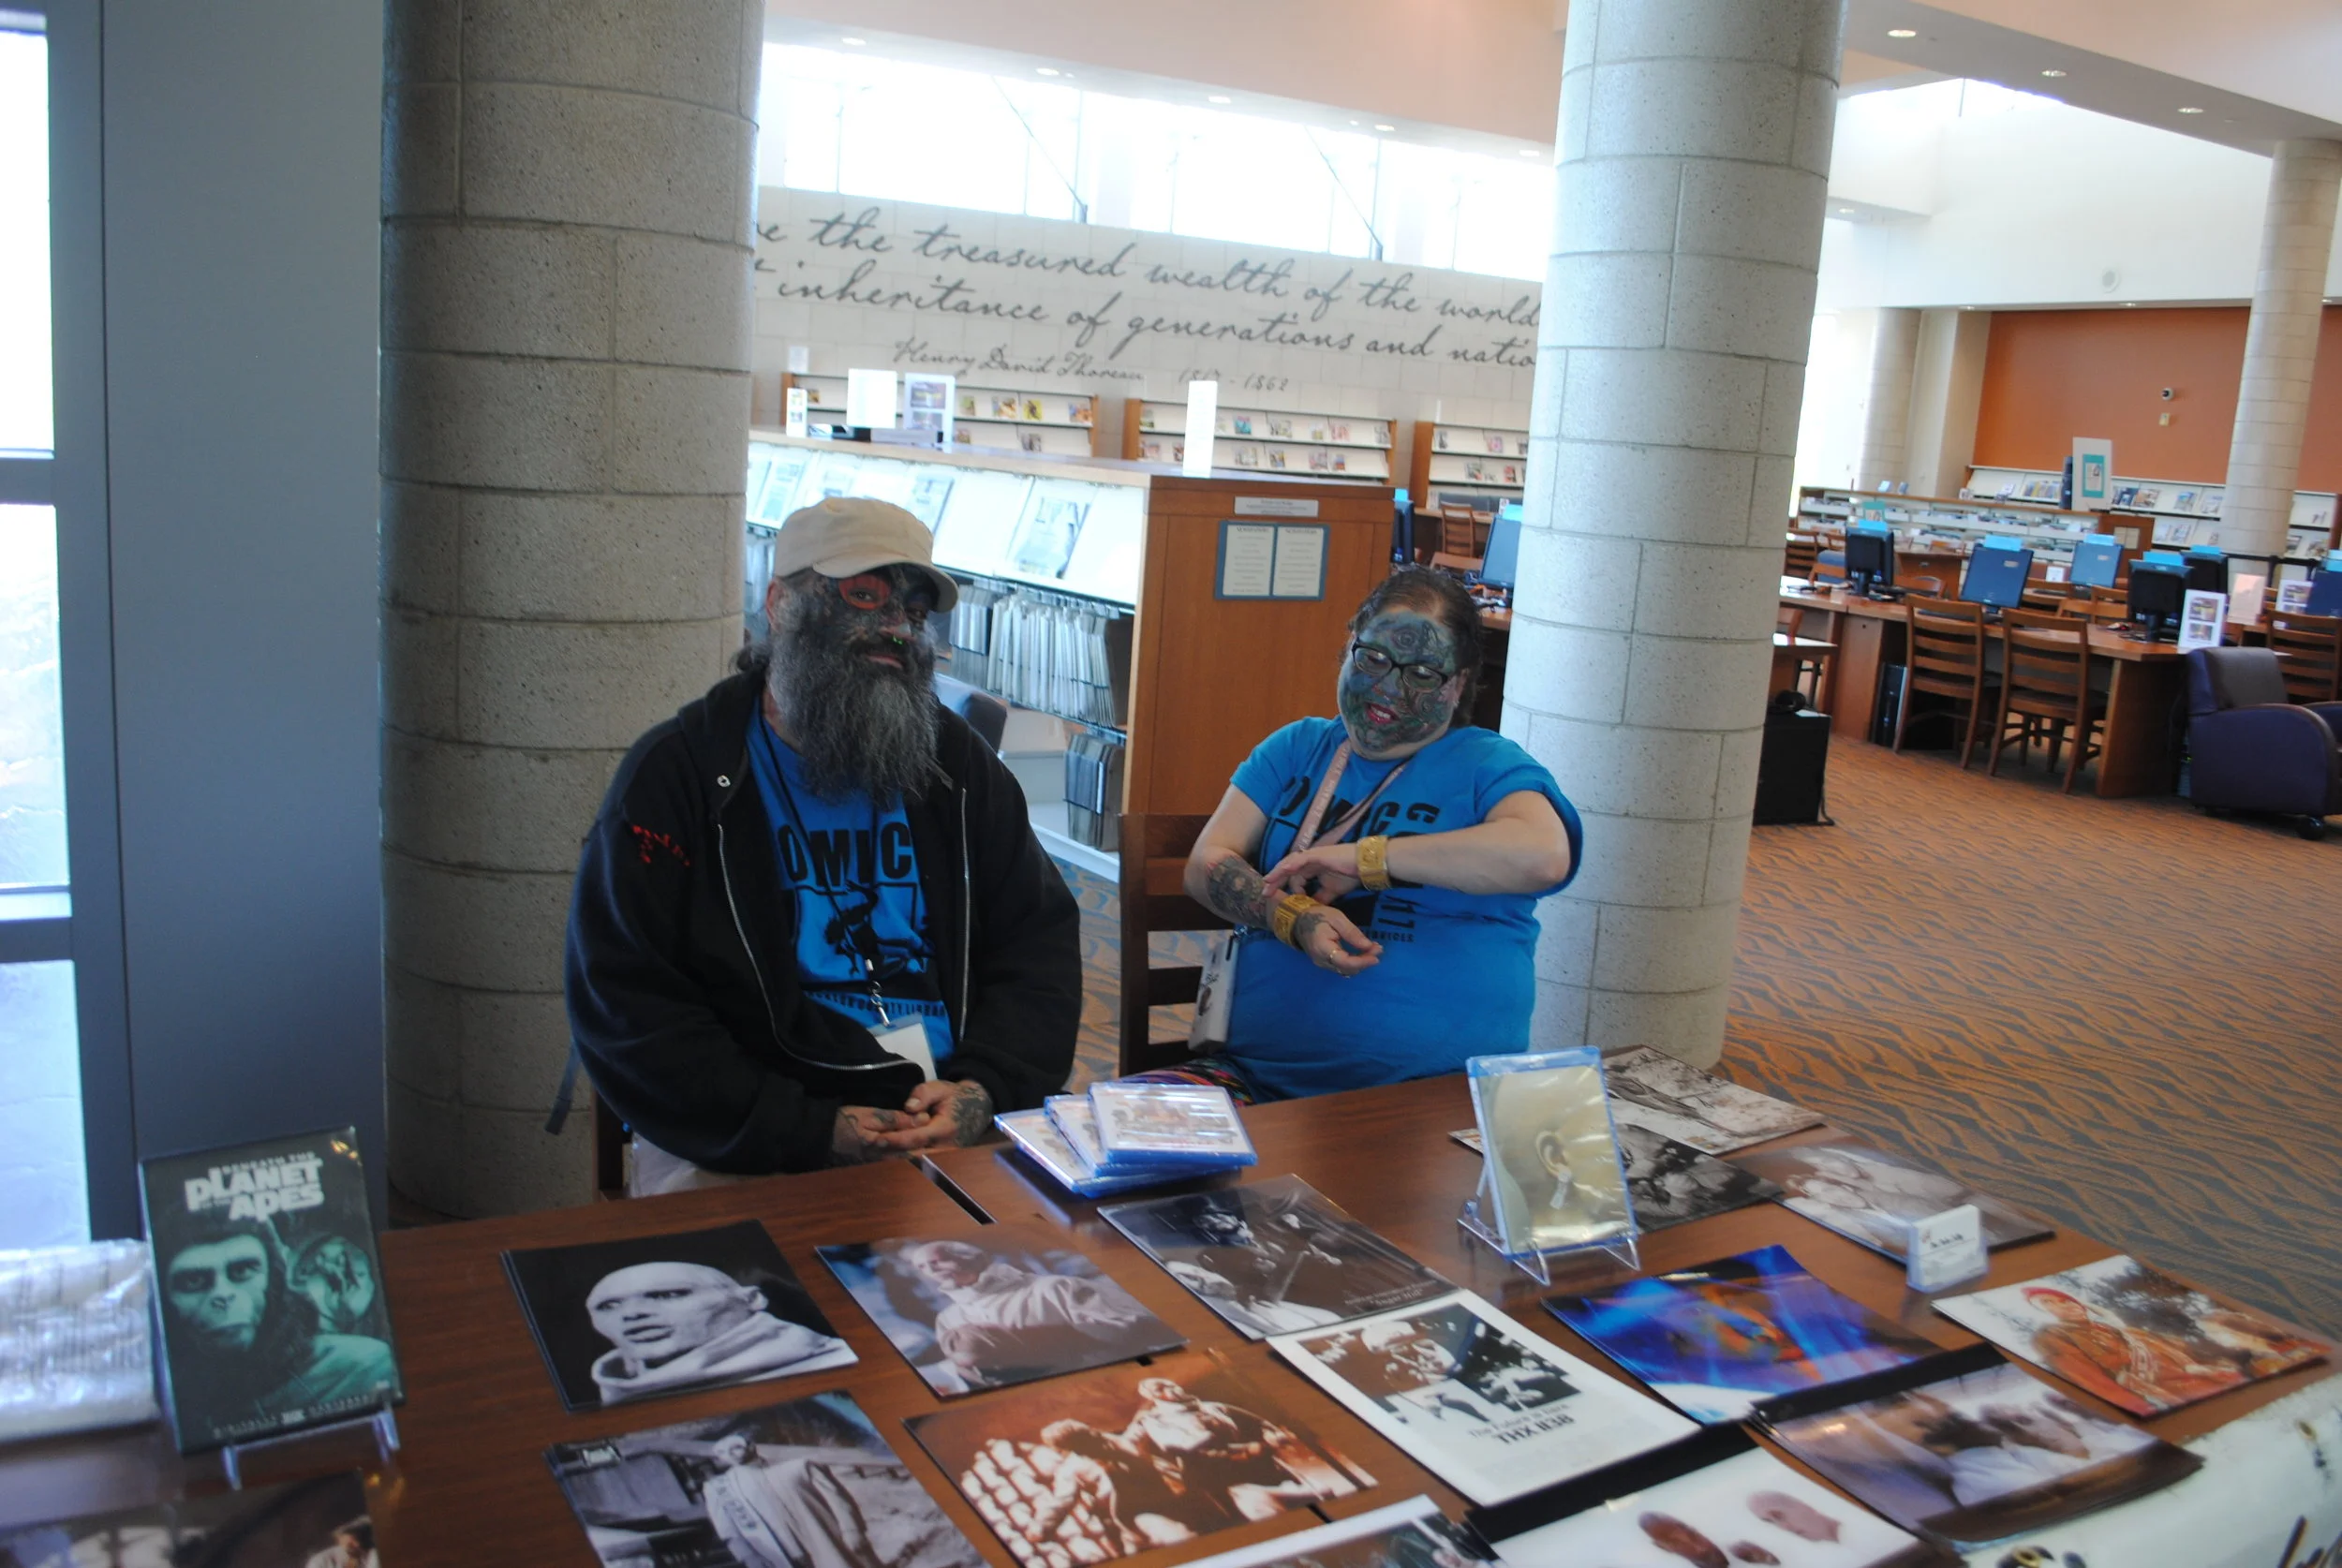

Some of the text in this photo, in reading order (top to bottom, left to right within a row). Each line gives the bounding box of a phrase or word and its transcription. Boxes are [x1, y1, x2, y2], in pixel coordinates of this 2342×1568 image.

[808, 205, 895, 253] the
[913, 223, 1135, 279] treasured
[1143, 258, 1296, 299] wealth
[1303, 267, 1355, 320] of
[1359, 272, 1422, 315] the
[1434, 294, 1541, 328] world
[778, 258, 1051, 322] inheritance
[1066, 290, 1123, 349] of
[1109, 311, 1357, 362] generations
[1366, 324, 1444, 358] and
[892, 336, 976, 378] Henry
[977, 343, 1056, 375] David
[1056, 348, 1143, 380] Thoreau
[185, 1157, 324, 1212] PLANET
[228, 1182, 325, 1223] APES
